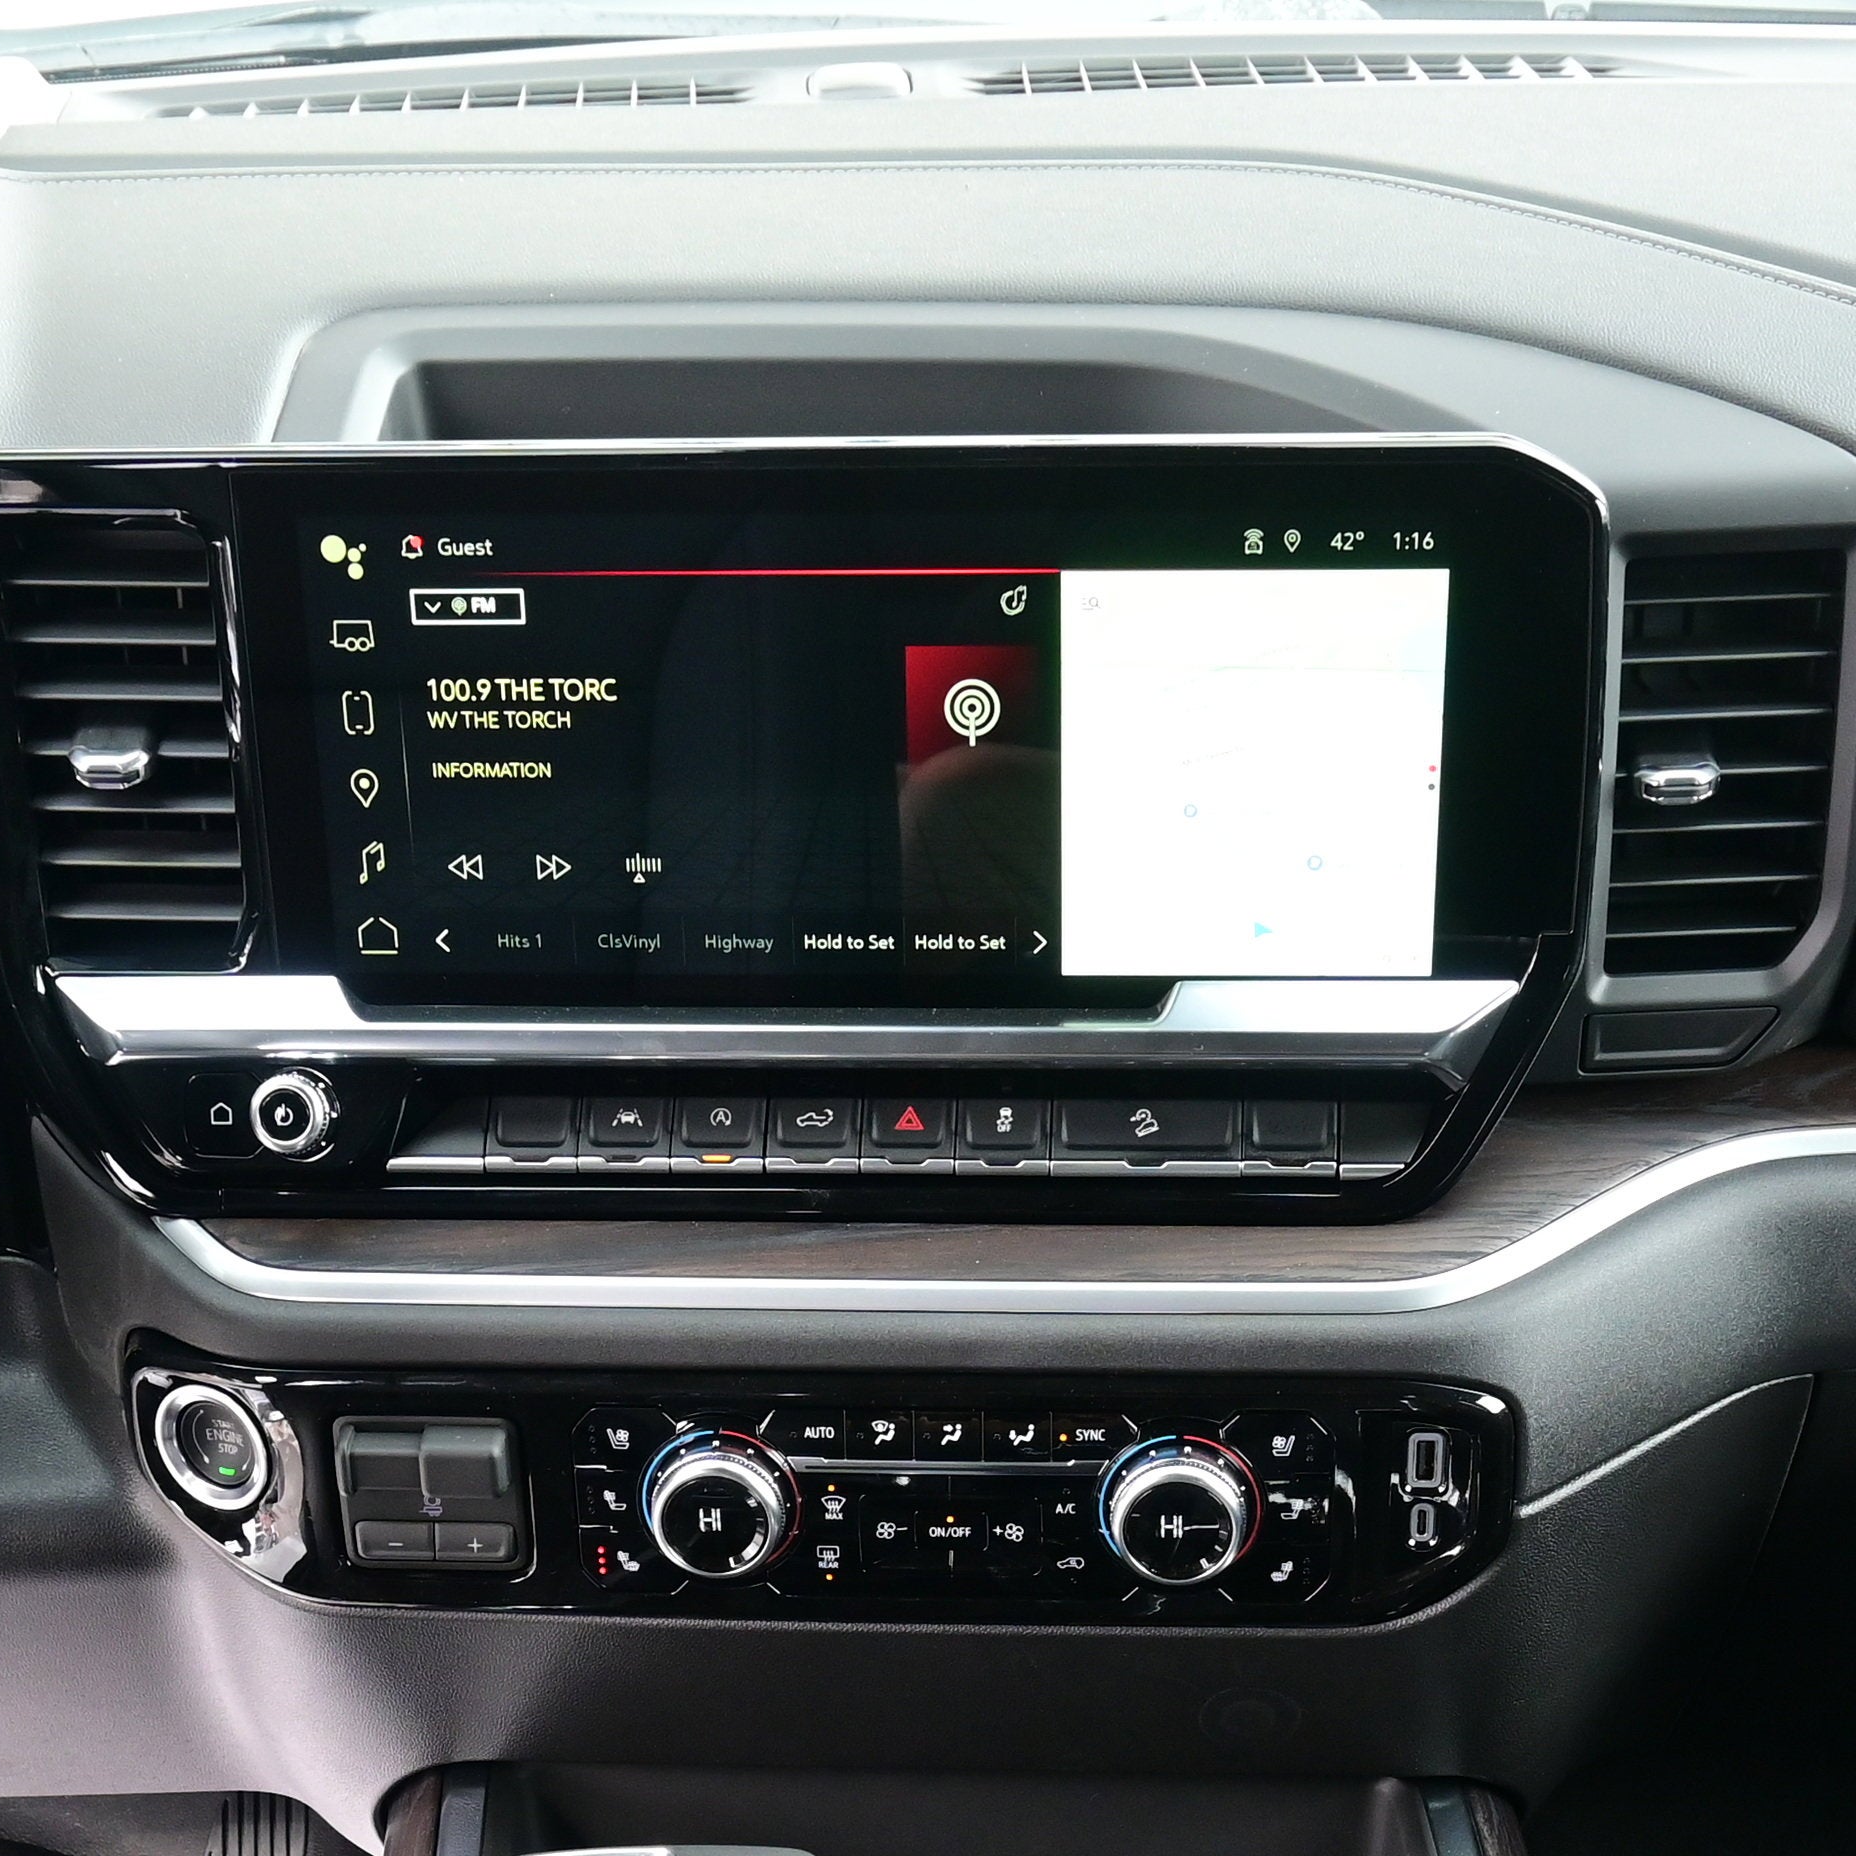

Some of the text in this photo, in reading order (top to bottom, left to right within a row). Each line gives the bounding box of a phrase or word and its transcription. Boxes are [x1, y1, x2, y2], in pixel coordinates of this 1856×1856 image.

[438, 538, 493, 556] Guest
[1330, 531, 1365, 551] 42°
[1393, 531, 1434, 550] 1:16
[471, 597, 496, 613] FM
[426, 678, 618, 702] 100.9 THE TORC
[427, 710, 571, 729] WV THE TORCH
[432, 762, 552, 779] INFORMATION
[497, 933, 542, 949] Hits 1
[597, 933, 661, 952] ClsVinyl
[704, 933, 774, 953] Highway
[804, 934, 895, 950] Hold to Set
[915, 934, 1006, 950] Hold to Set
[997, 1124, 1012, 1133] OFF
[206, 1428, 244, 1447] ENGINE
[804, 1426, 835, 1439] AUTO
[1075, 1429, 1106, 1442] SYNC
[218, 1442, 239, 1455] STOP
[825, 1512, 843, 1520] MAX
[1055, 1503, 1076, 1514] A/C
[699, 1508, 721, 1532] HI
[1160, 1514, 1183, 1539] HI
[929, 1527, 972, 1538] ON/OFF
[818, 1561, 839, 1569] REAR
